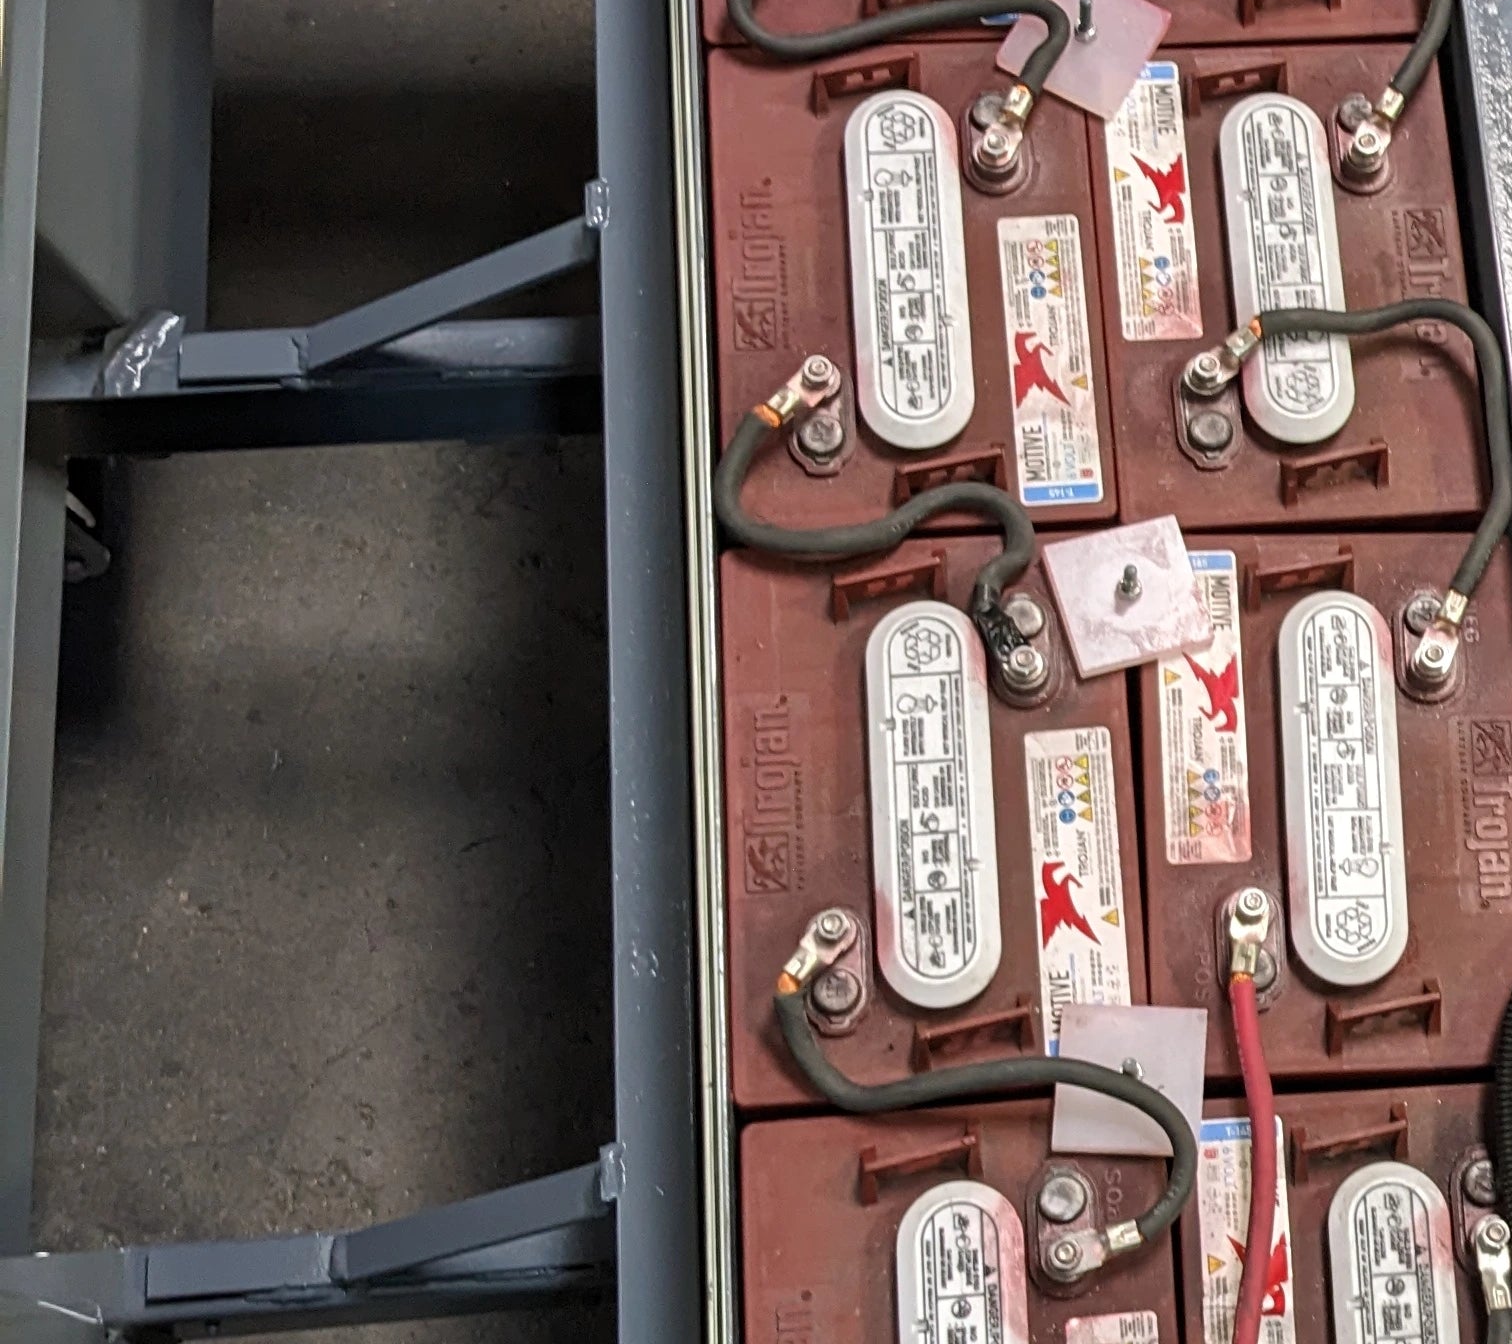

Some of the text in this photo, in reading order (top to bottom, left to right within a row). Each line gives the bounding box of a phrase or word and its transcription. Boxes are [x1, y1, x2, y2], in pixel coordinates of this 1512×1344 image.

[1153, 83, 1177, 135] MOTIVE
[1021, 425, 1046, 482] MOTIVE
[1209, 574, 1232, 631] MOTIVE
[739, 709, 803, 835] Trojan
